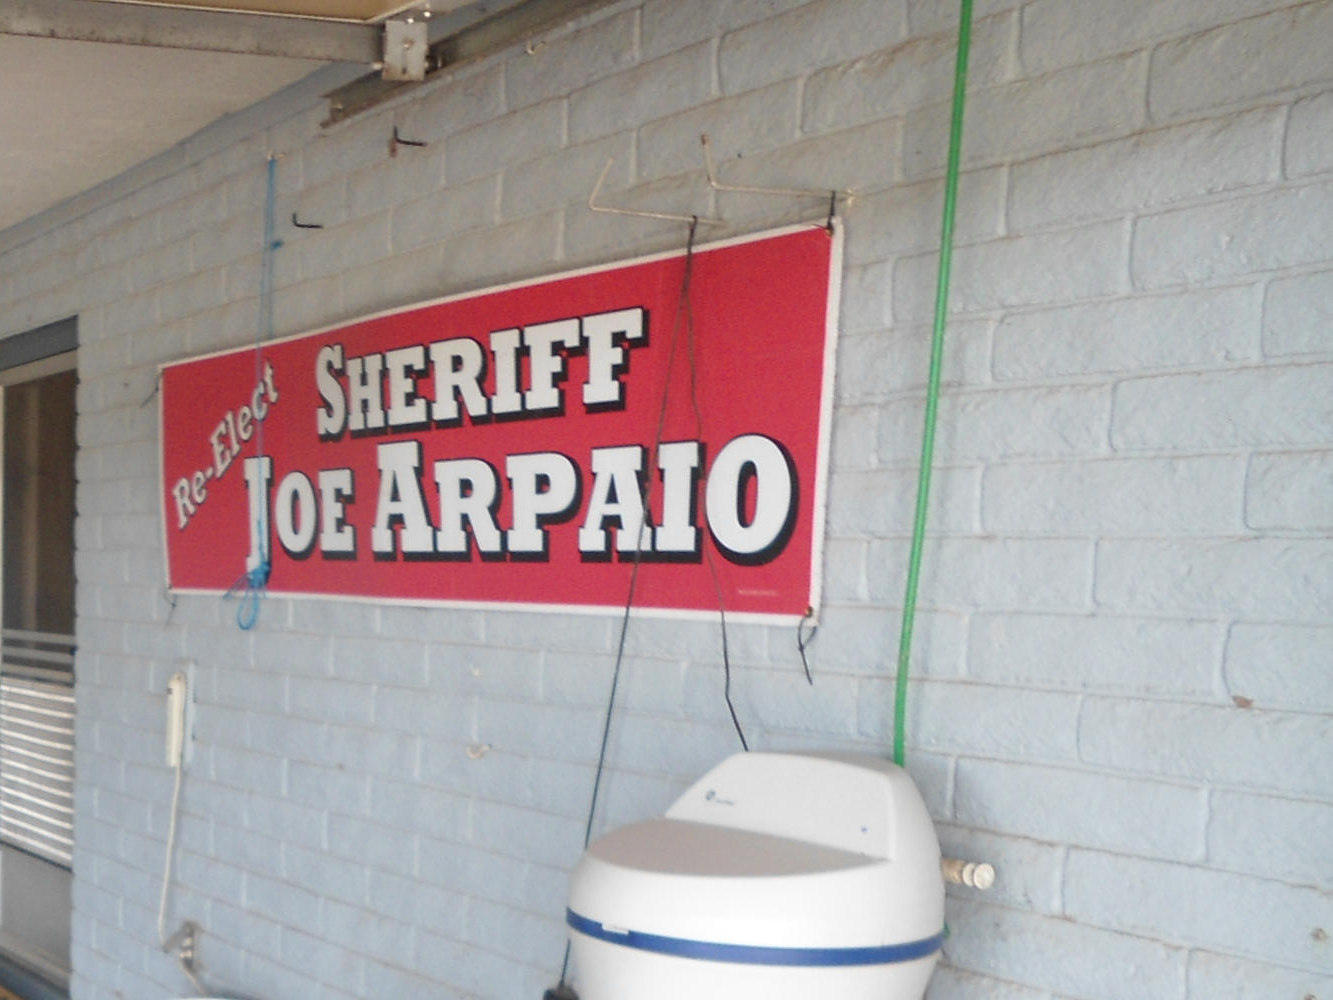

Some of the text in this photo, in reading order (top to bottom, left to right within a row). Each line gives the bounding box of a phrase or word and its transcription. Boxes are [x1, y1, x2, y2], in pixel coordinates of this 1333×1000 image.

[172, 358, 279, 530] Re-Elect
[315, 306, 649, 440] SHERIFF
[243, 434, 797, 588] JOE ARPAIO
